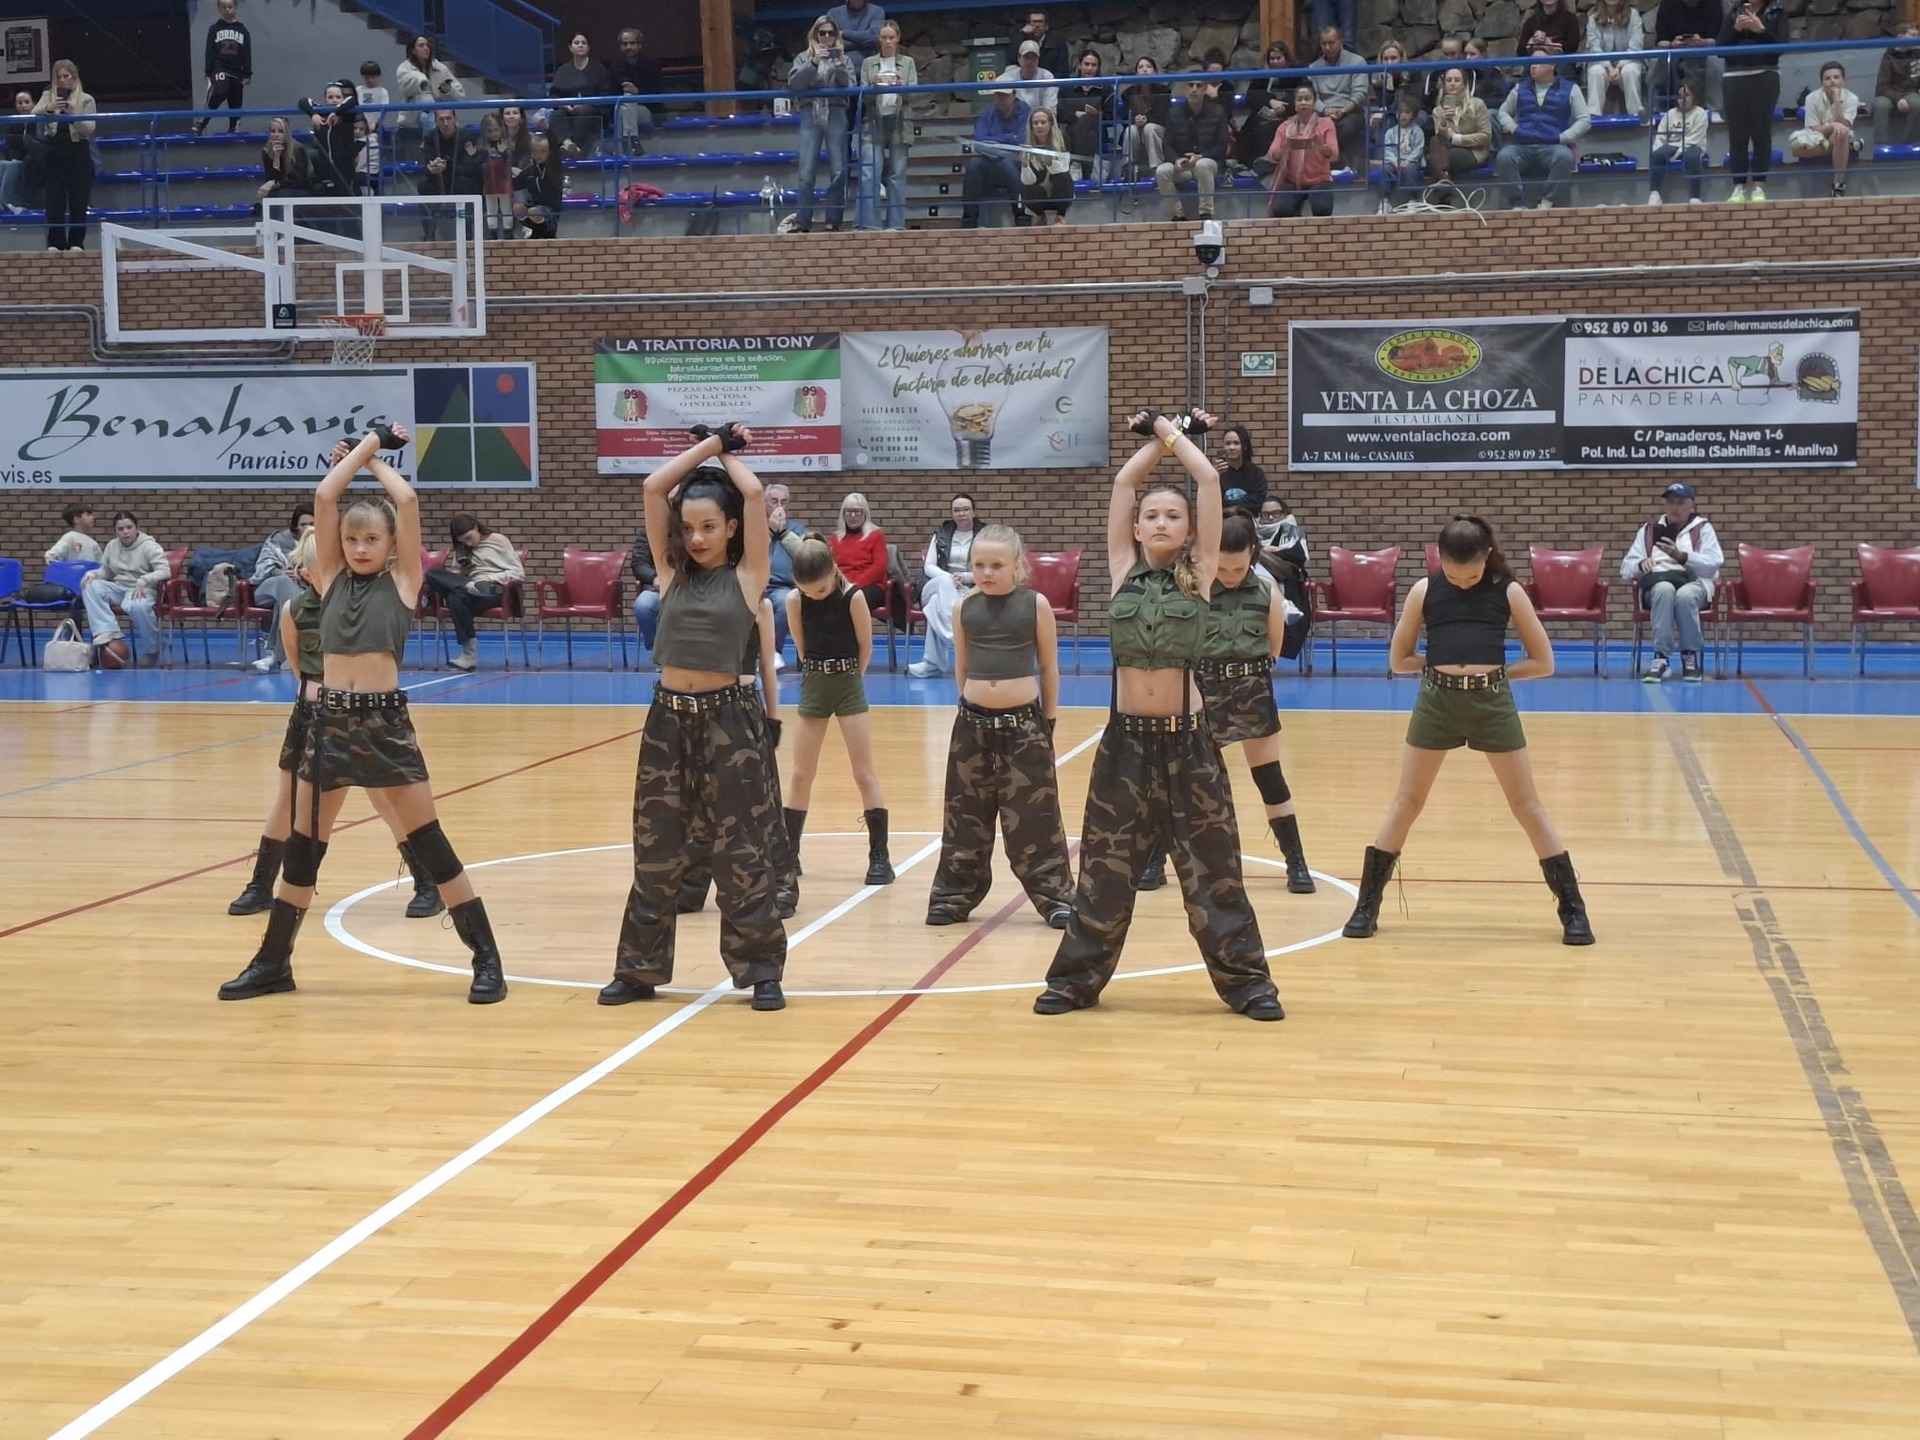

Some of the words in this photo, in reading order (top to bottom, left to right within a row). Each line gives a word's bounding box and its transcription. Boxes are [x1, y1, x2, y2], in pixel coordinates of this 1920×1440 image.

[215, 30, 244, 45] JORDAN
[215, 72, 225, 81] 10
[1584, 321, 1609, 334] 952
[1613, 321, 1629, 333] 89
[1633, 320, 1647, 333] 01
[1652, 320, 1668, 332] 36
[1706, 318, 1853, 331] info@hermanosdelachica.com
[616, 339, 638, 352] LA
[642, 337, 740, 351] TRATTORIA
[744, 337, 761, 349] DI
[766, 335, 815, 348] TONY
[953, 338, 1012, 360] ahorrar
[1015, 339, 1035, 352] en
[1036, 331, 1054, 353] tu
[1579, 356, 1721, 366] HERMANOS
[893, 371, 947, 398] factura
[951, 369, 971, 387] de
[974, 358, 1076, 388] electricidad?
[624, 389, 638, 400] 99
[802, 385, 817, 396] 99
[1320, 390, 1399, 411] VENTA
[1407, 389, 1438, 410] LA
[1445, 387, 1538, 410] CHOZA
[1579, 391, 1722, 406] PANADERIA
[1374, 413, 1482, 424] RESTAURANTE
[1346, 430, 1511, 442] www.ventalachoza.com
[1655, 429, 1726, 443] Panaderos,
[1729, 429, 1761, 441] Nave
[1764, 429, 1784, 440] 1-6
[1302, 451, 1319, 461] A-7
[1323, 451, 1341, 461] KM
[1345, 451, 1360, 461] 146
[1369, 451, 1415, 461] CASARES
[1487, 450, 1506, 460] 952
[1508, 450, 1520, 459] 89
[1523, 449, 1535, 459] 09
[1538, 449, 1551, 459] 25
[1581, 446, 1604, 458] Pol.
[1606, 446, 1628, 458] Ind.
[1631, 446, 1646, 458] La
[1649, 444, 1705, 458] Dehesilla
[1708, 444, 1772, 458] (Sabinillas
[1784, 443, 1838, 457] Manilva)
